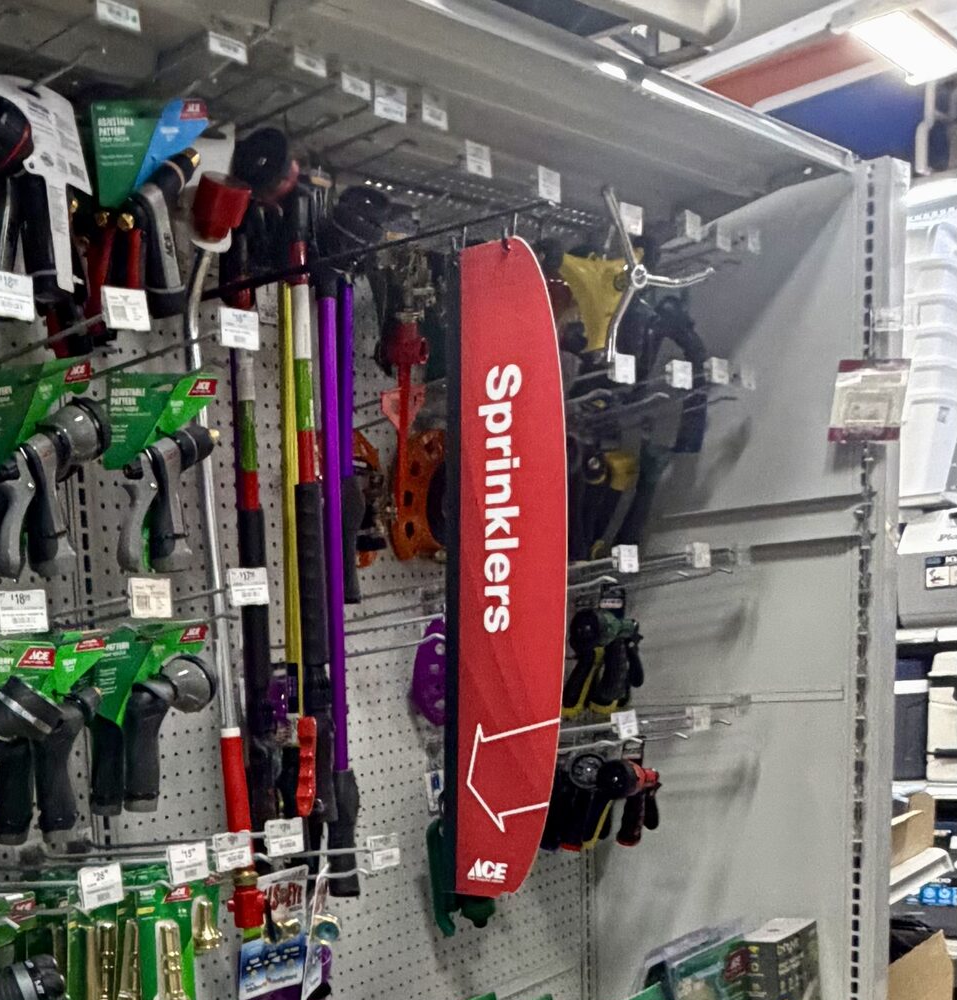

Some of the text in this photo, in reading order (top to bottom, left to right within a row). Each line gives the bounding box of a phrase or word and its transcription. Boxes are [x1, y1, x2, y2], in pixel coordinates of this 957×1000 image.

[478, 363, 522, 633] Sprinklers
[29, 650, 50, 660] ACE
[467, 857, 508, 880] ACE
